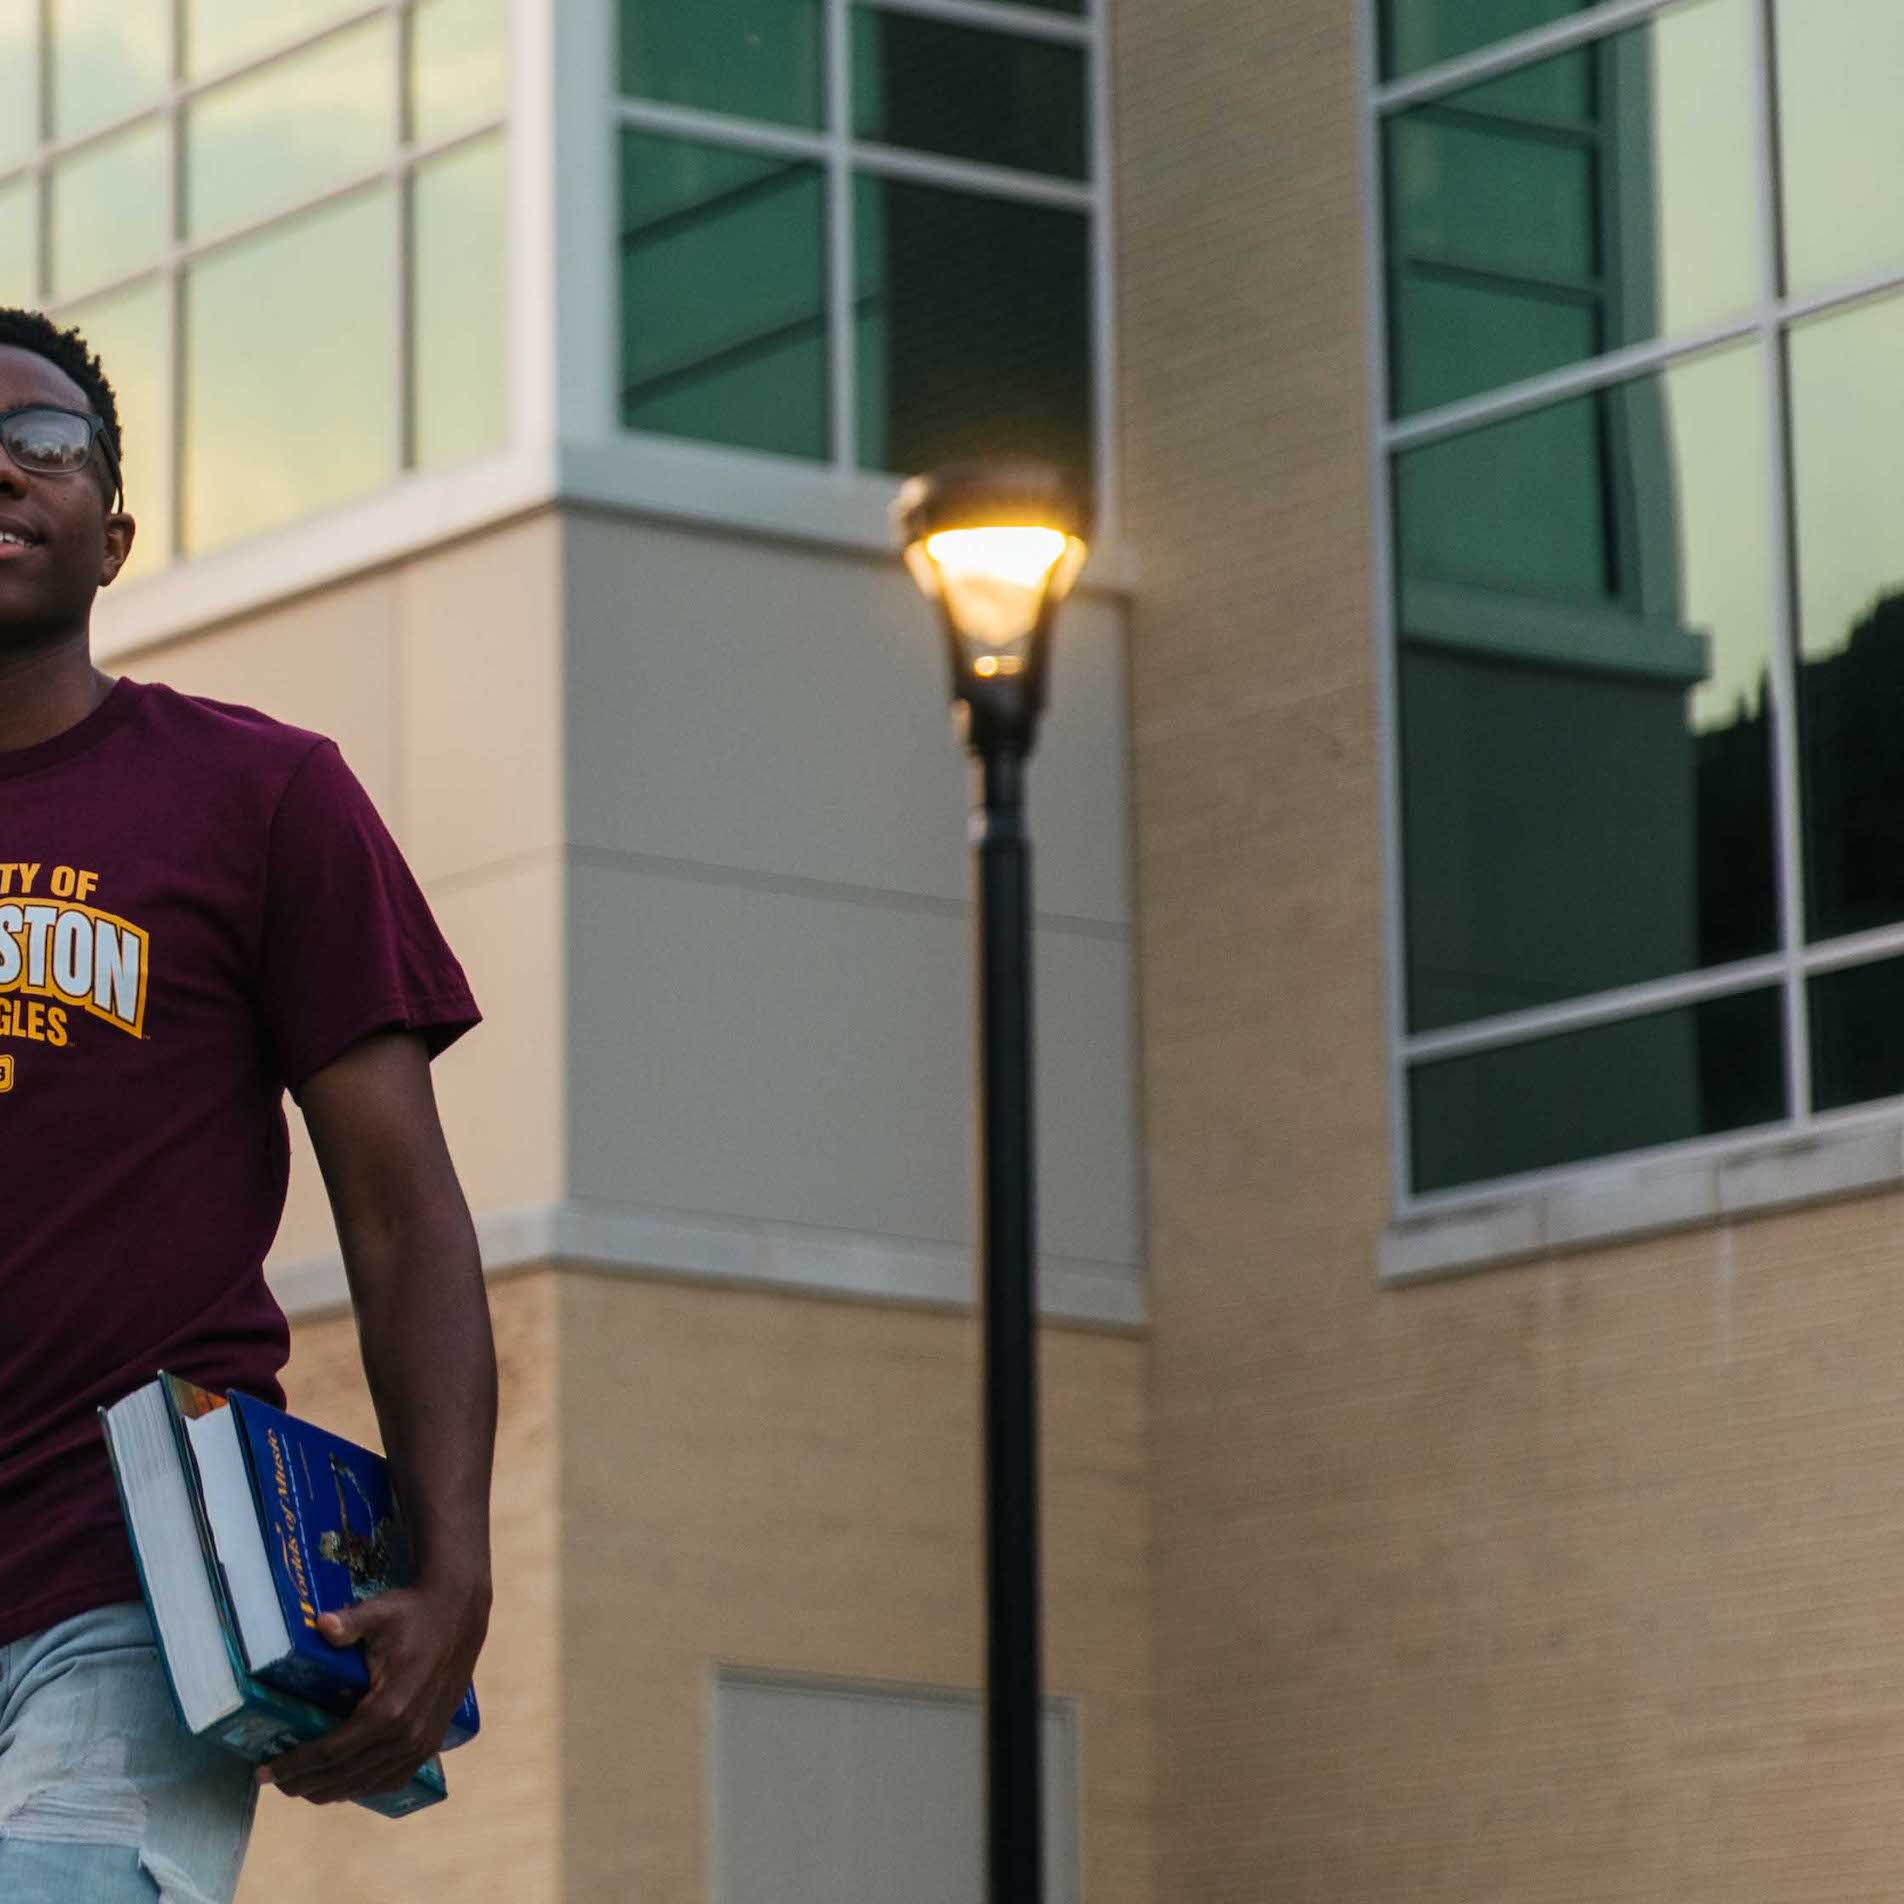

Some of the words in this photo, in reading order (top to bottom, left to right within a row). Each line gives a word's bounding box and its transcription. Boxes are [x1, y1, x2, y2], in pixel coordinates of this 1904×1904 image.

[50, 866, 99, 901] OF
[267, 1427, 288, 1498] Music
[280, 1498, 297, 1532] of
